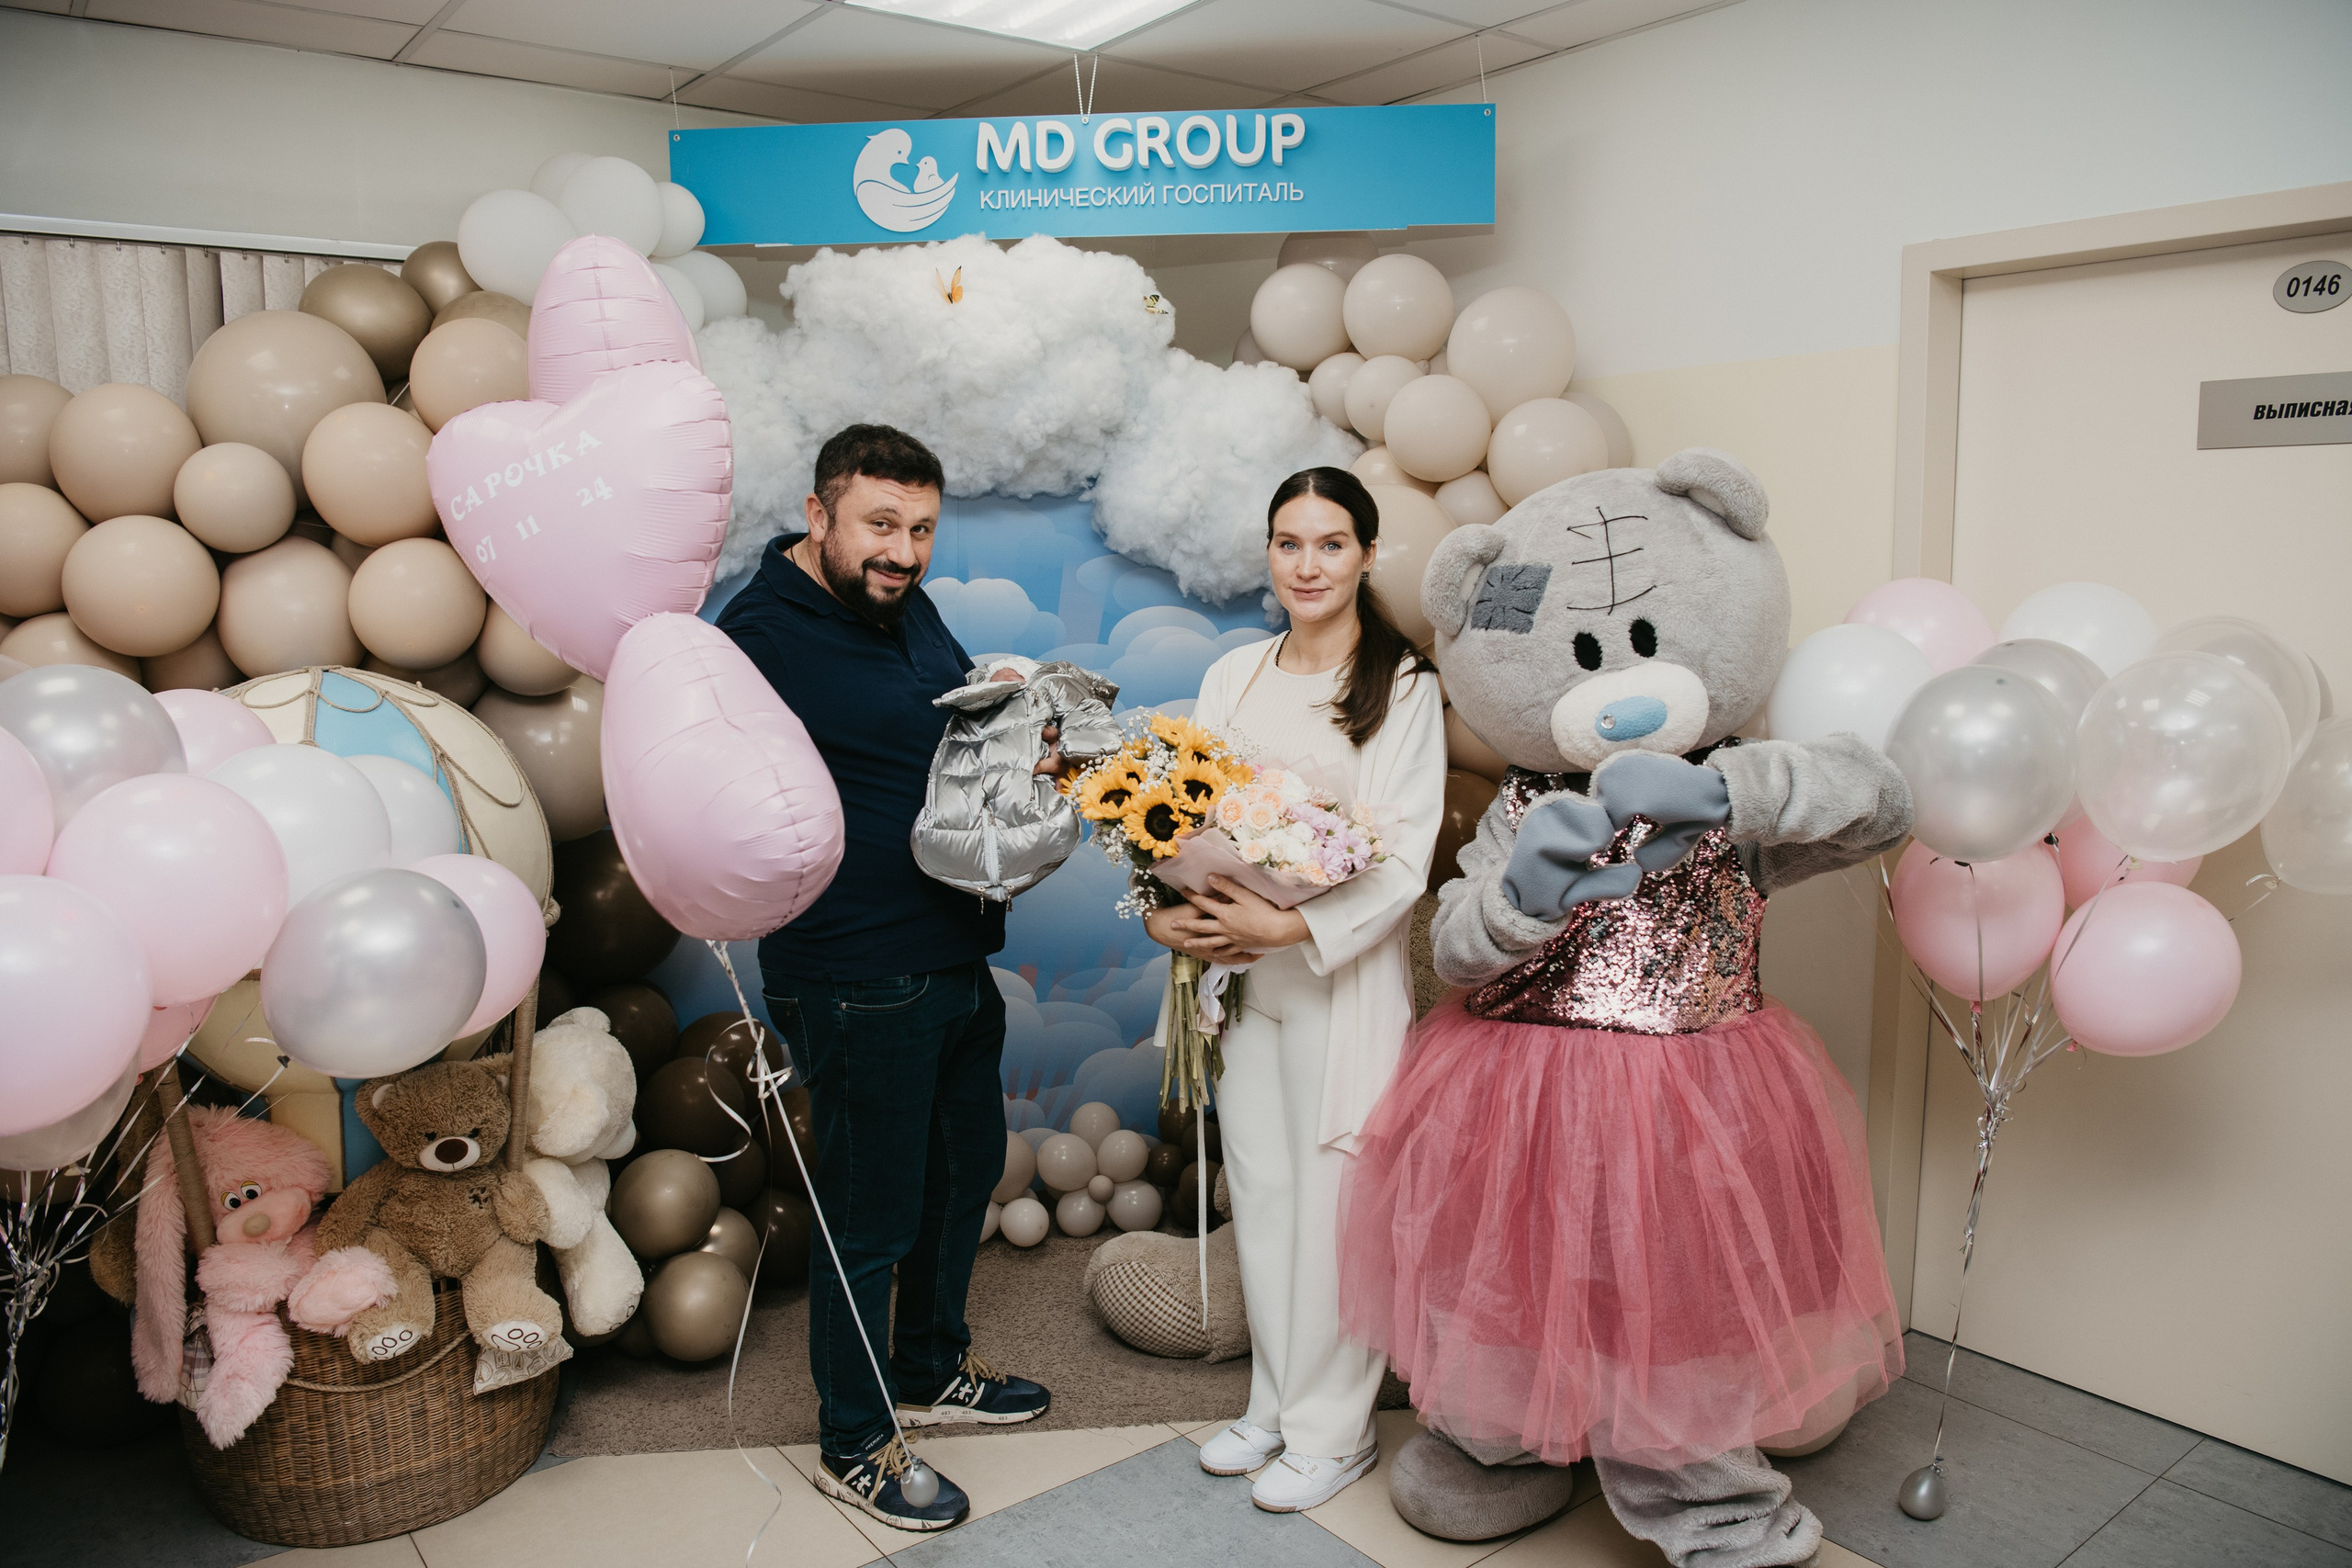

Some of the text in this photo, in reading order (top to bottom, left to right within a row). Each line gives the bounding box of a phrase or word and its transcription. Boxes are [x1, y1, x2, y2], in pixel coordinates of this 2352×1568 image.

[976, 113, 1306, 173] MD GROUP
[979, 182, 1305, 209] КЛИНИЧЕСКИЙ ГОСПИТАЛЬ
[2286, 275, 2342, 298] 0146
[449, 430, 603, 521] САРОЧКА
[476, 476, 614, 563] 07 11 24
